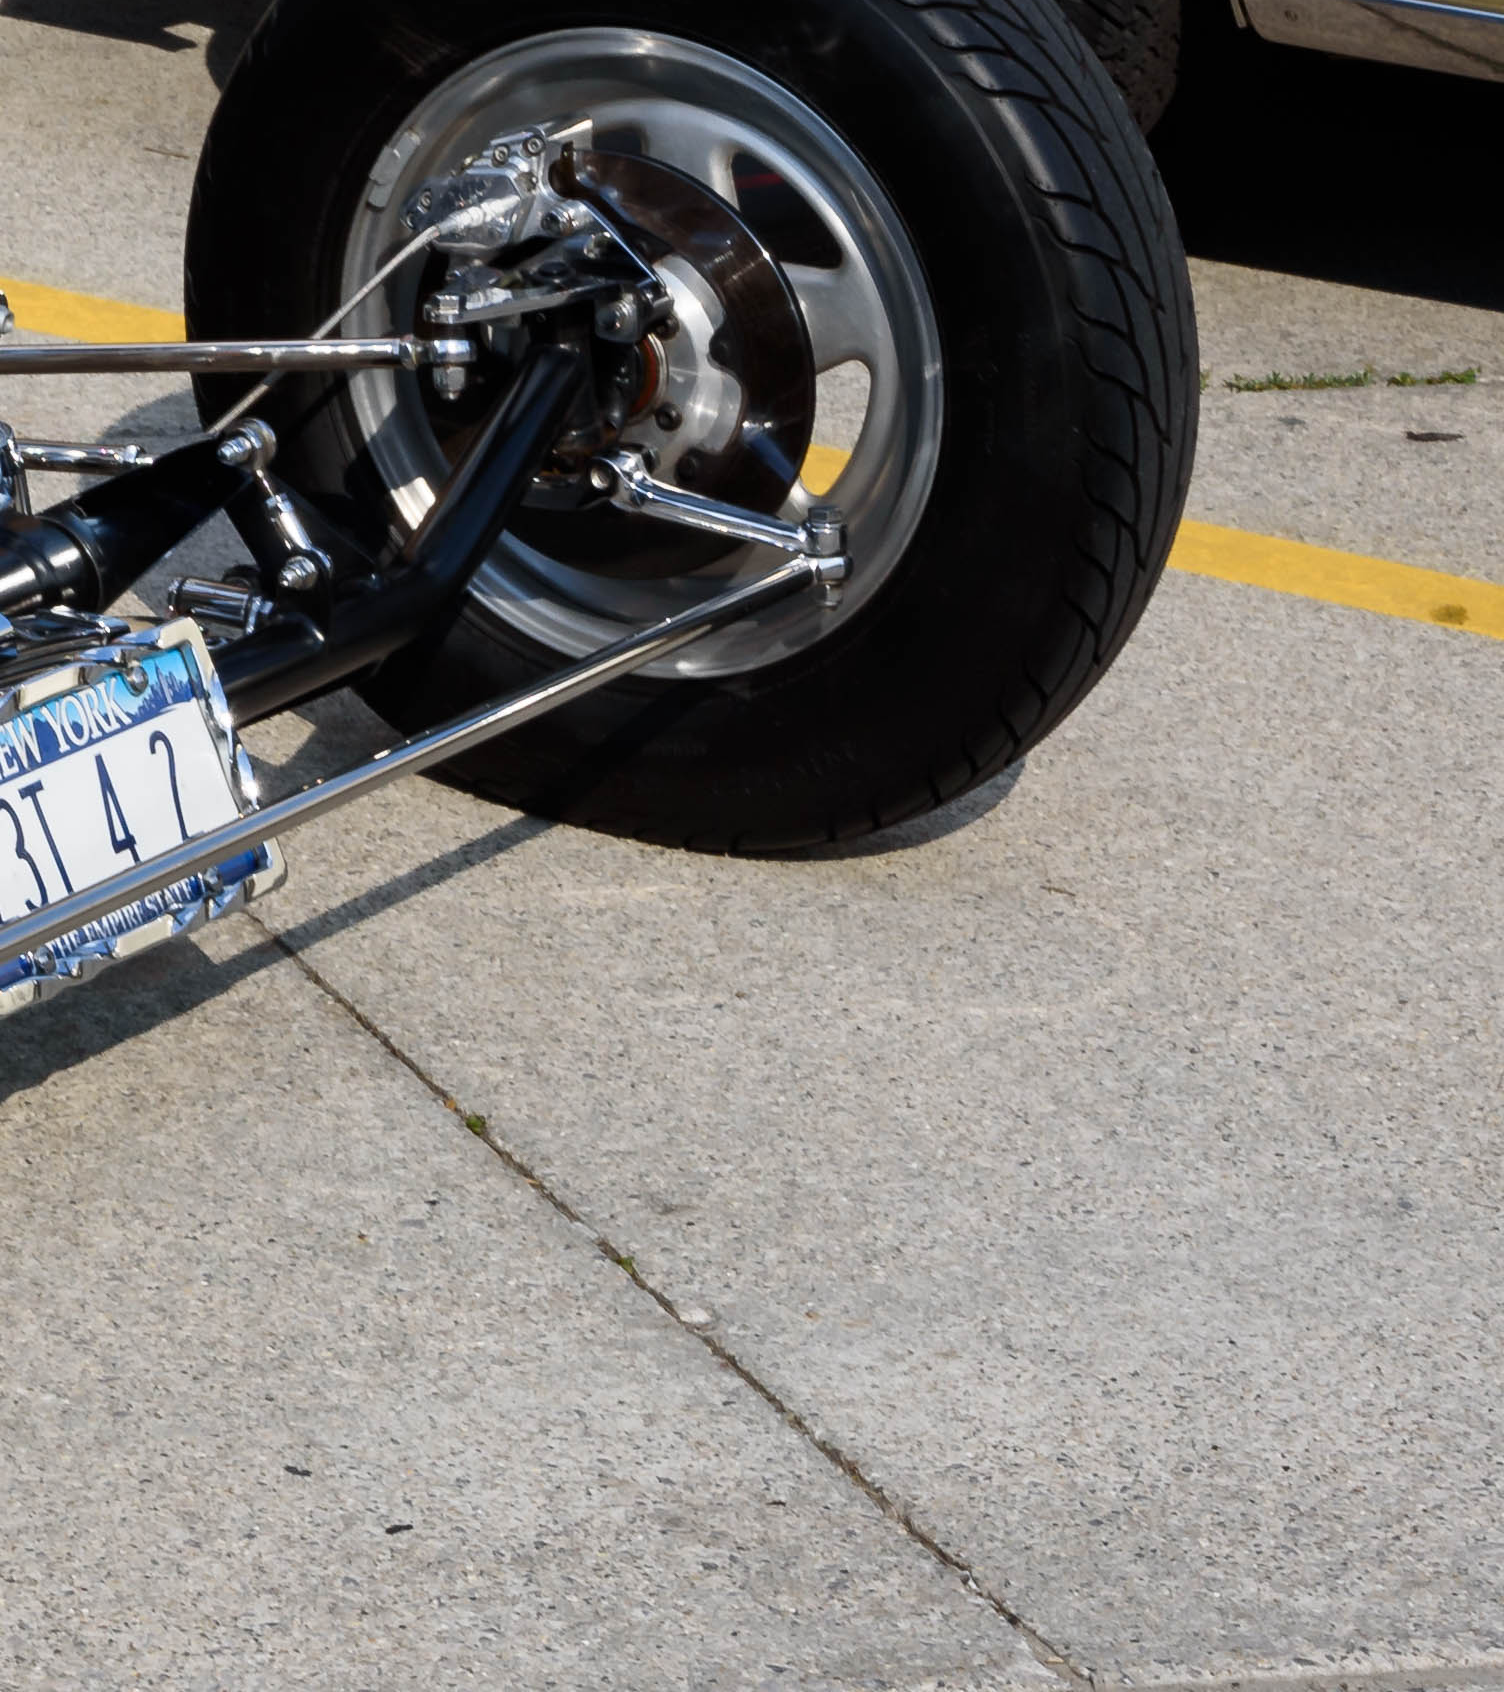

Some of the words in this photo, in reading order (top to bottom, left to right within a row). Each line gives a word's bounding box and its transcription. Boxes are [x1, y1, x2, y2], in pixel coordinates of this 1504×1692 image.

[40, 679, 132, 752] YORK
[94, 753, 141, 864] 4
[45, 927, 79, 957] THE
[81, 900, 143, 943] EMPIRE
[144, 876, 193, 914] STATE
